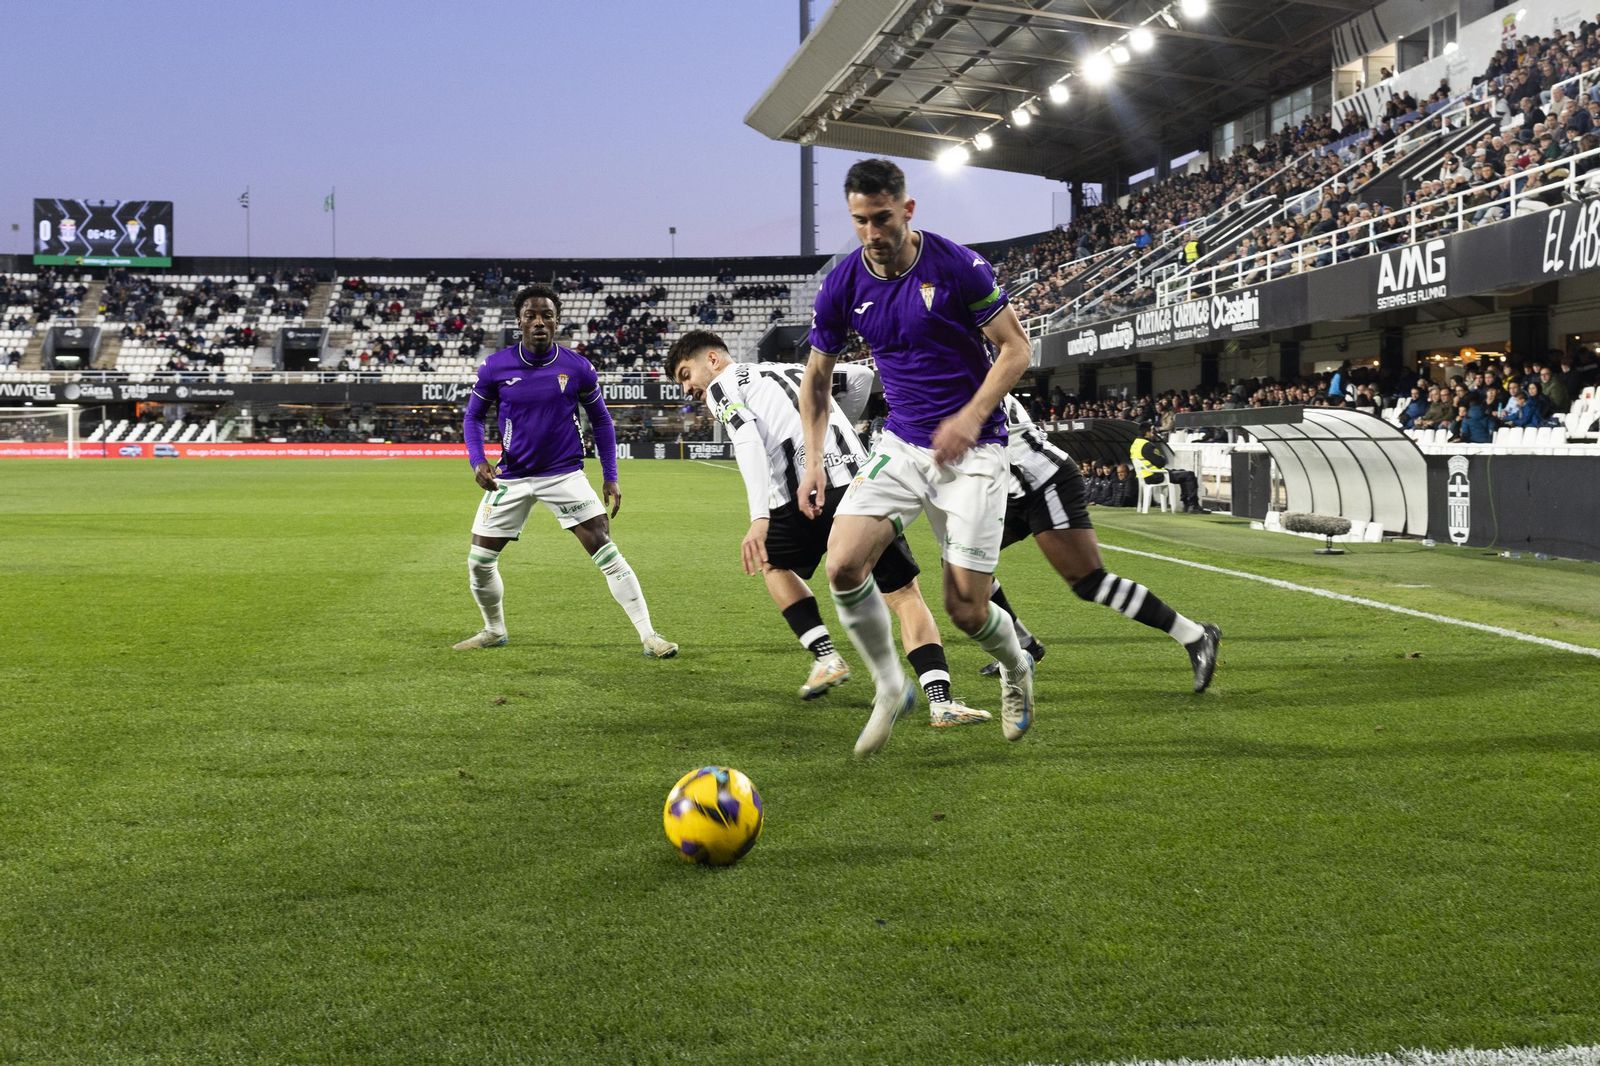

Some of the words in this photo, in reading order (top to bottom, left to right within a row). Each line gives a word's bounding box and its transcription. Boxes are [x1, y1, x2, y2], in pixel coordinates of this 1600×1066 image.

[1542, 208, 1567, 273] EL
[1569, 199, 1600, 271] AB
[1377, 238, 1447, 295] AMG
[1407, 291, 1417, 304] DE
[422, 384, 443, 400] FCC
[603, 383, 647, 400] FÚTBOL
[660, 384, 680, 400] FCC
